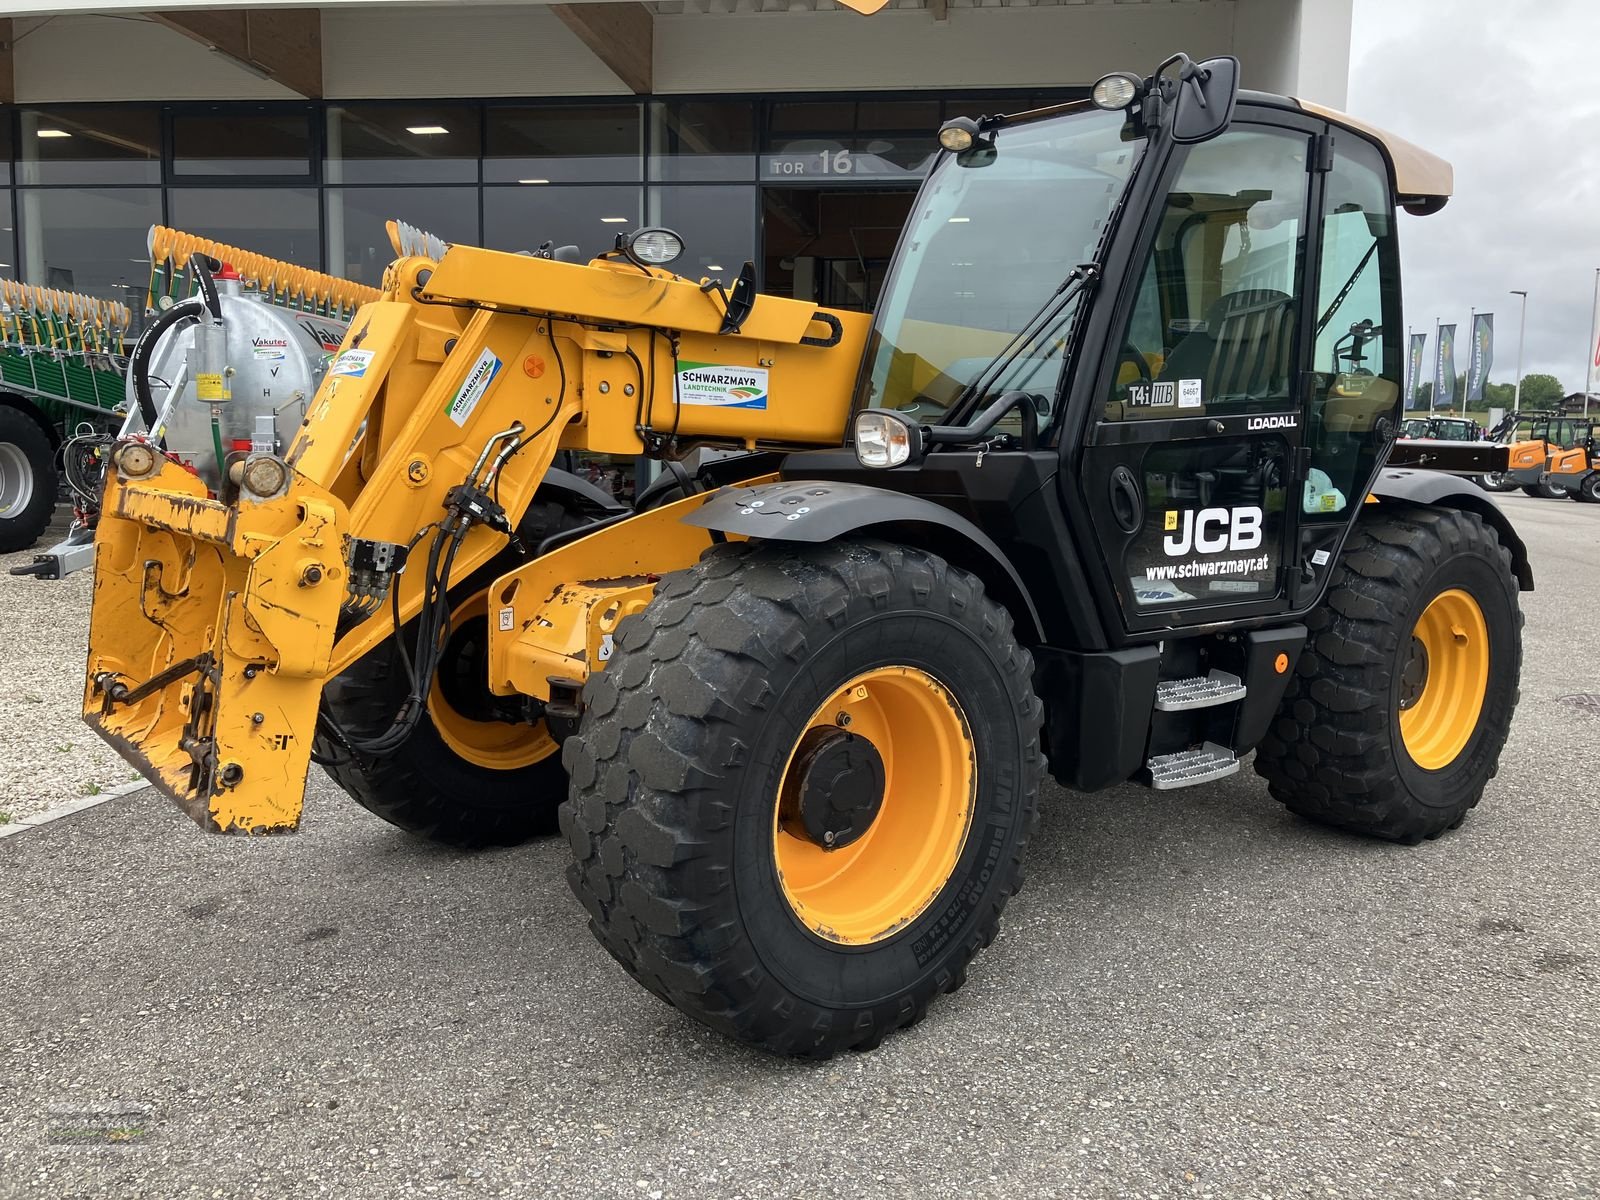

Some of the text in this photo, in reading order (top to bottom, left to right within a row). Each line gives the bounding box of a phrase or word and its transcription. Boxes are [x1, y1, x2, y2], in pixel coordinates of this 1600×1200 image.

[773, 150, 852, 174] TOR 16
[252, 337, 287, 347] Vakutec
[298, 321, 344, 350] Vaku
[270, 367, 279, 377] V
[682, 372, 756, 386] SCHWARZMAYR
[263, 388, 271, 397] H
[453, 360, 488, 413] SCHWARZMAYR
[683, 384, 727, 392] LANDTECHNIK
[1129, 386, 1150, 405] T4i
[1247, 415, 1297, 430] LOADALL
[1163, 506, 1263, 556] JCB
[1146, 554, 1269, 580] www.schwarzmayr.at
[969, 826, 1006, 906] BIBLOAD
